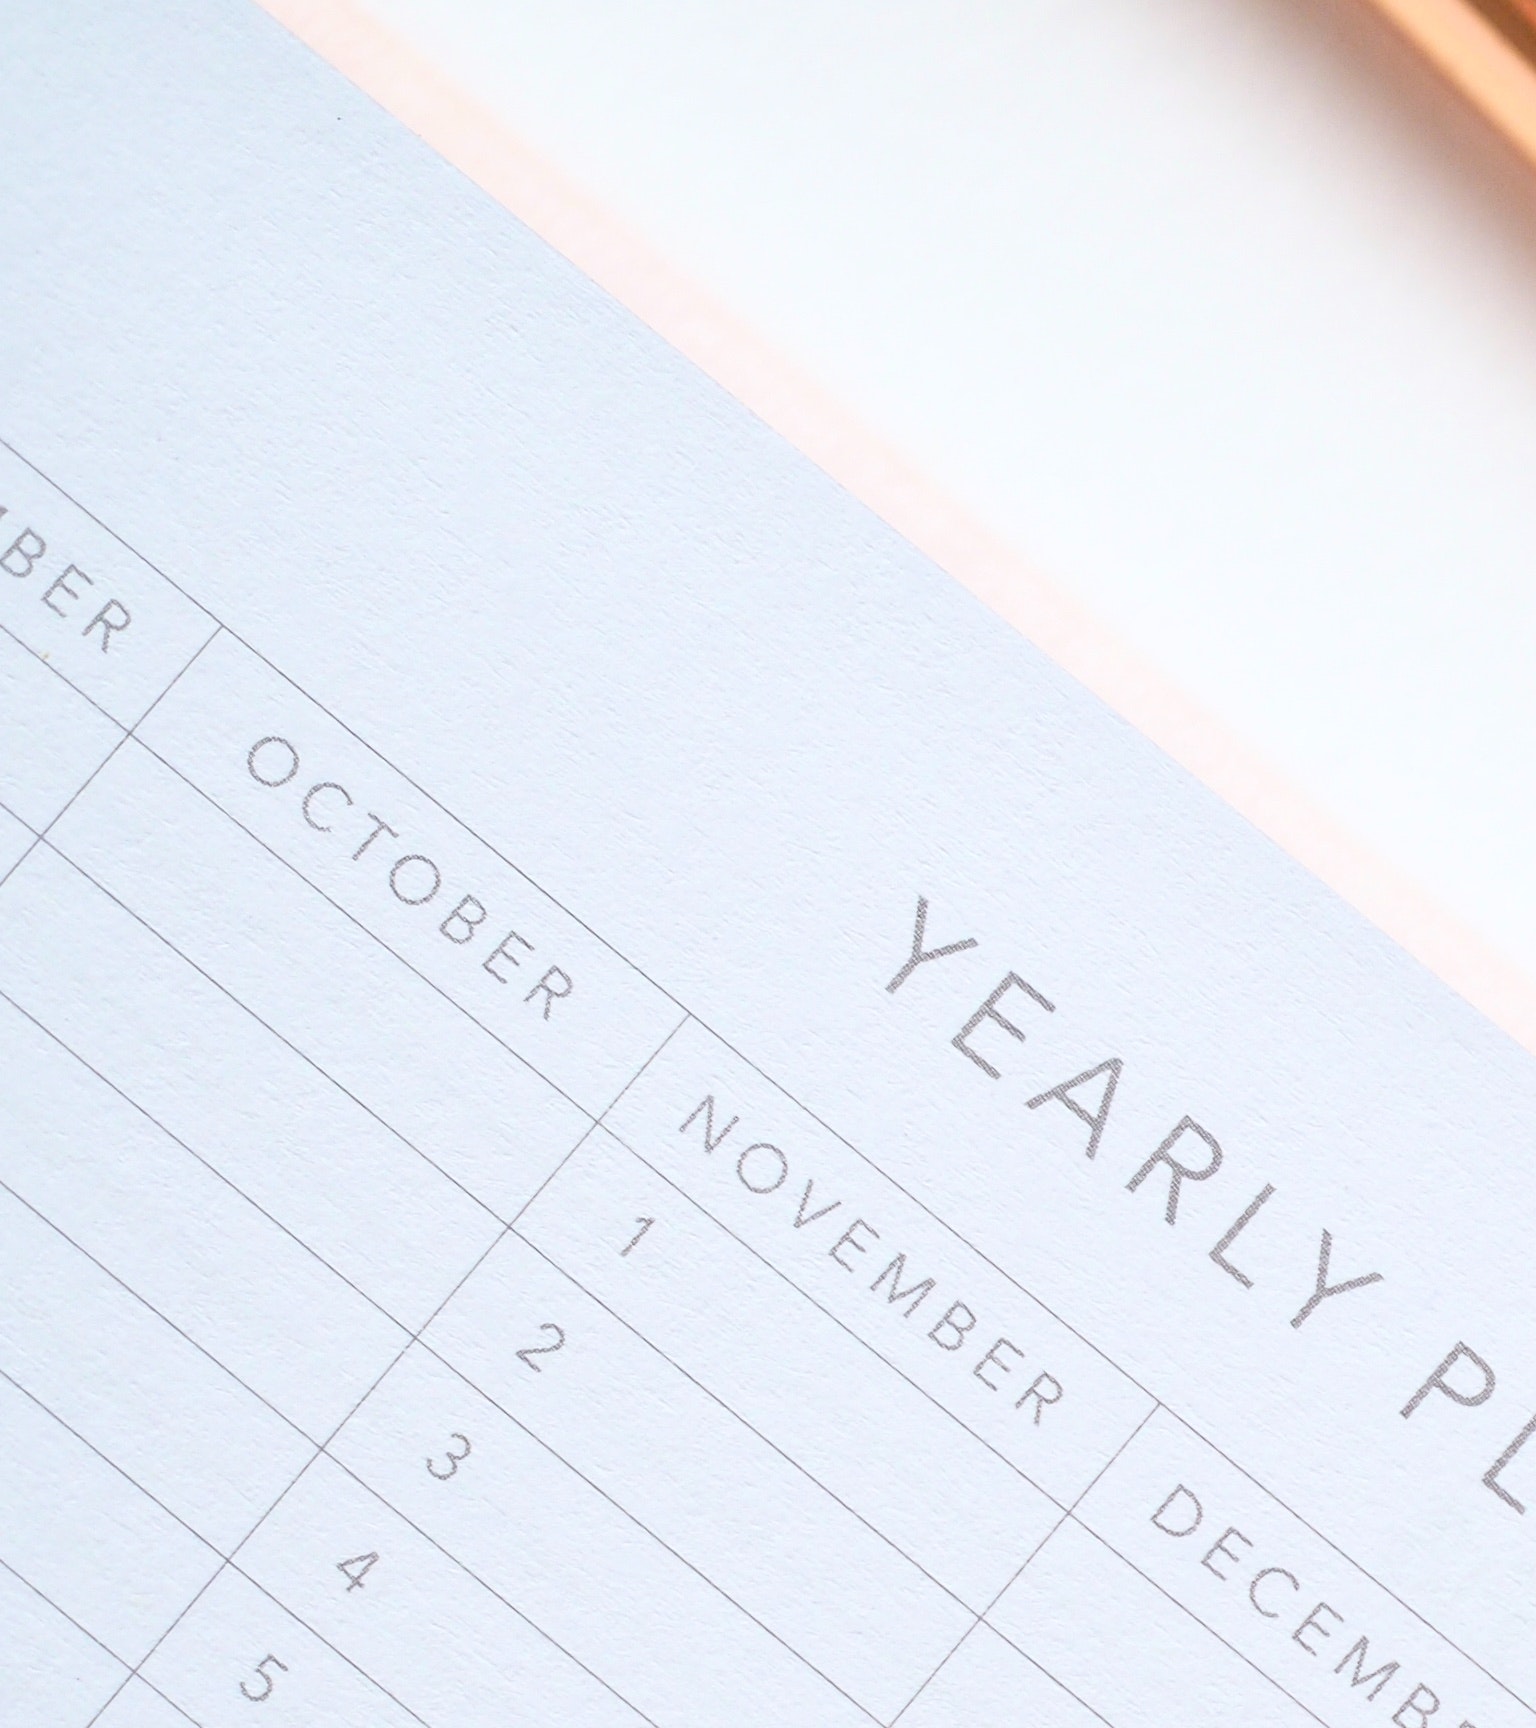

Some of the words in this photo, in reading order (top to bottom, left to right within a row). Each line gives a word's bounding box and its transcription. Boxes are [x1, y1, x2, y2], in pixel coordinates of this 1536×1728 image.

[0, 505, 131, 653] BER
[246, 735, 573, 1020] OCTOBER
[885, 895, 1384, 1329] YEARLY
[620, 1217, 655, 1257] 1
[679, 1094, 1064, 1426] NOVEMBER
[515, 1322, 566, 1373] 2
[426, 1432, 472, 1481] 3
[336, 1551, 379, 1593] 4
[239, 1653, 289, 1703] 5
